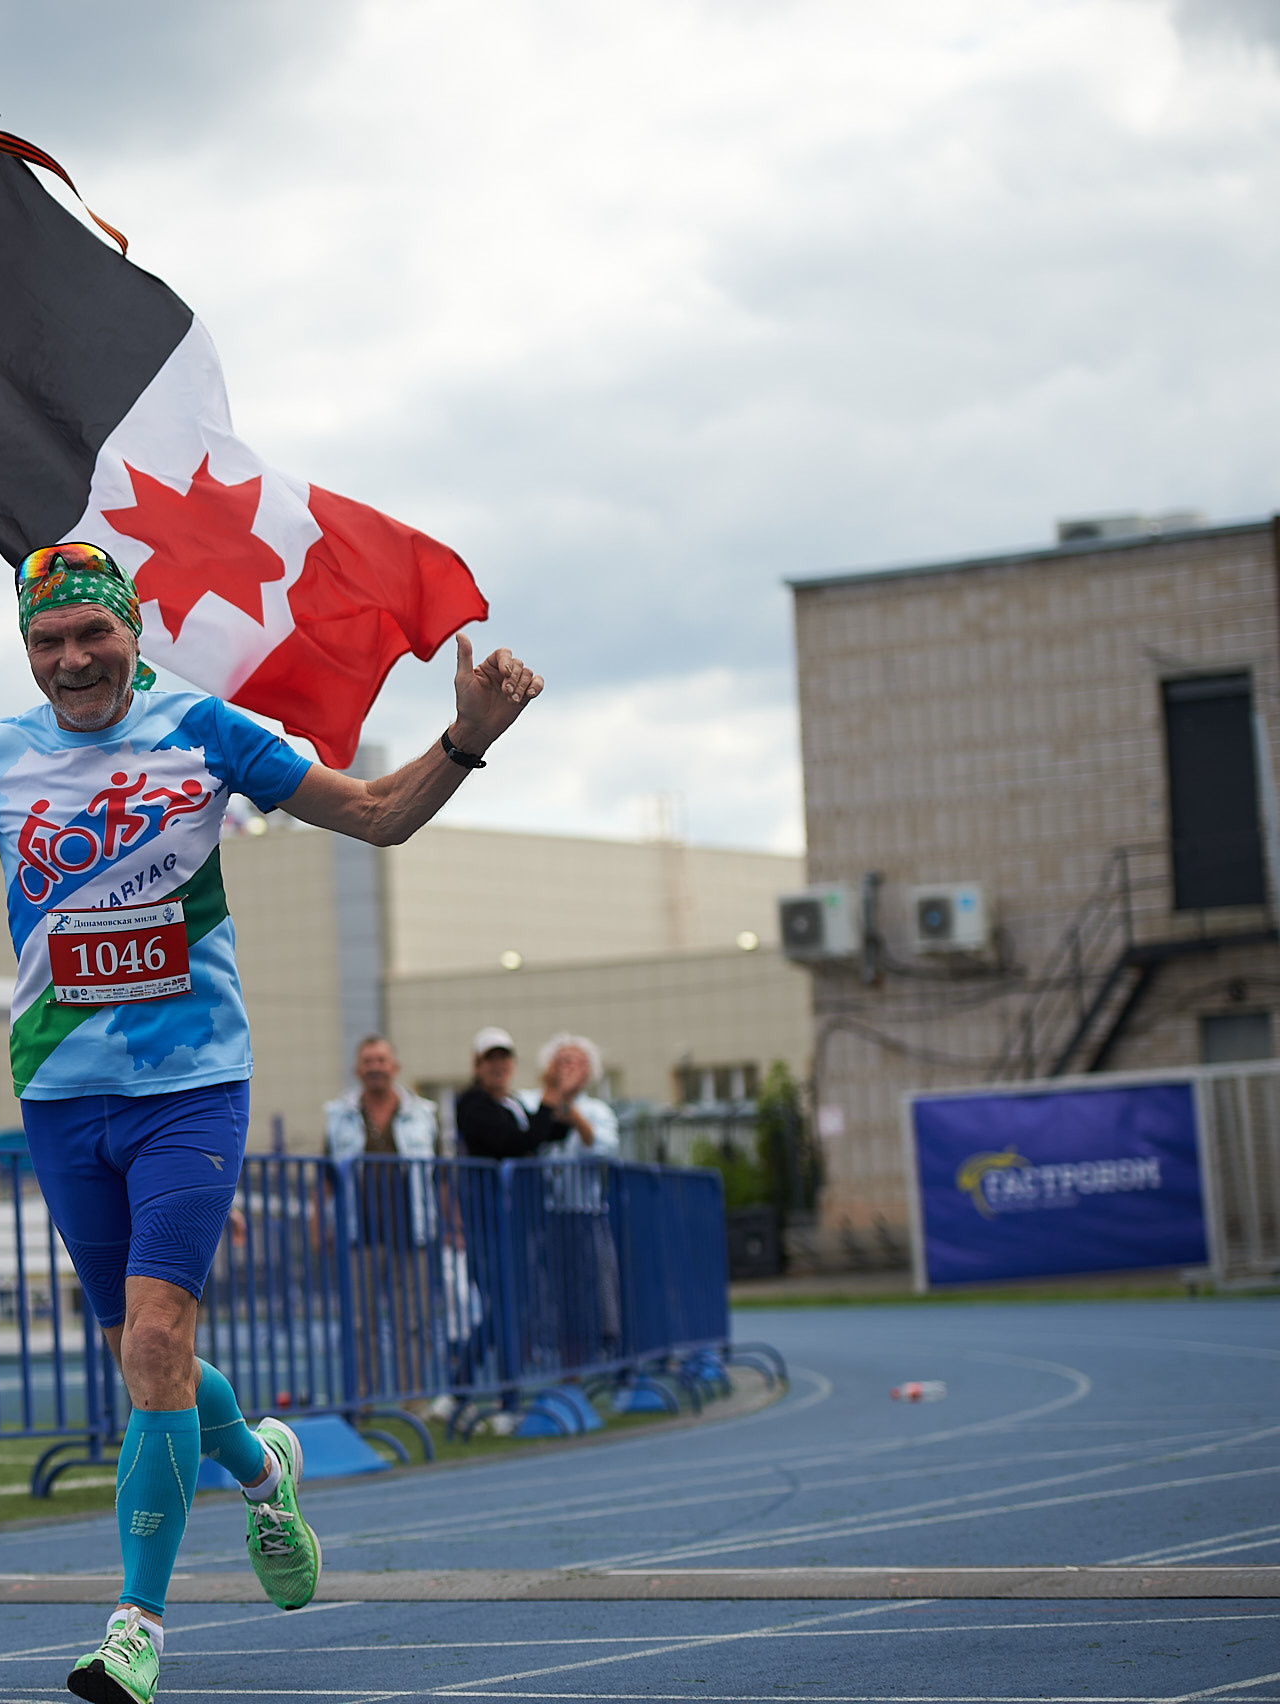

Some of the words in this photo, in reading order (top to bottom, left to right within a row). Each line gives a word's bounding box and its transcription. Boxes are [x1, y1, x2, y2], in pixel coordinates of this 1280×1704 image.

[73, 918, 132, 928] Динамовская
[134, 914, 158, 924] миля
[71, 935, 167, 977] 1046
